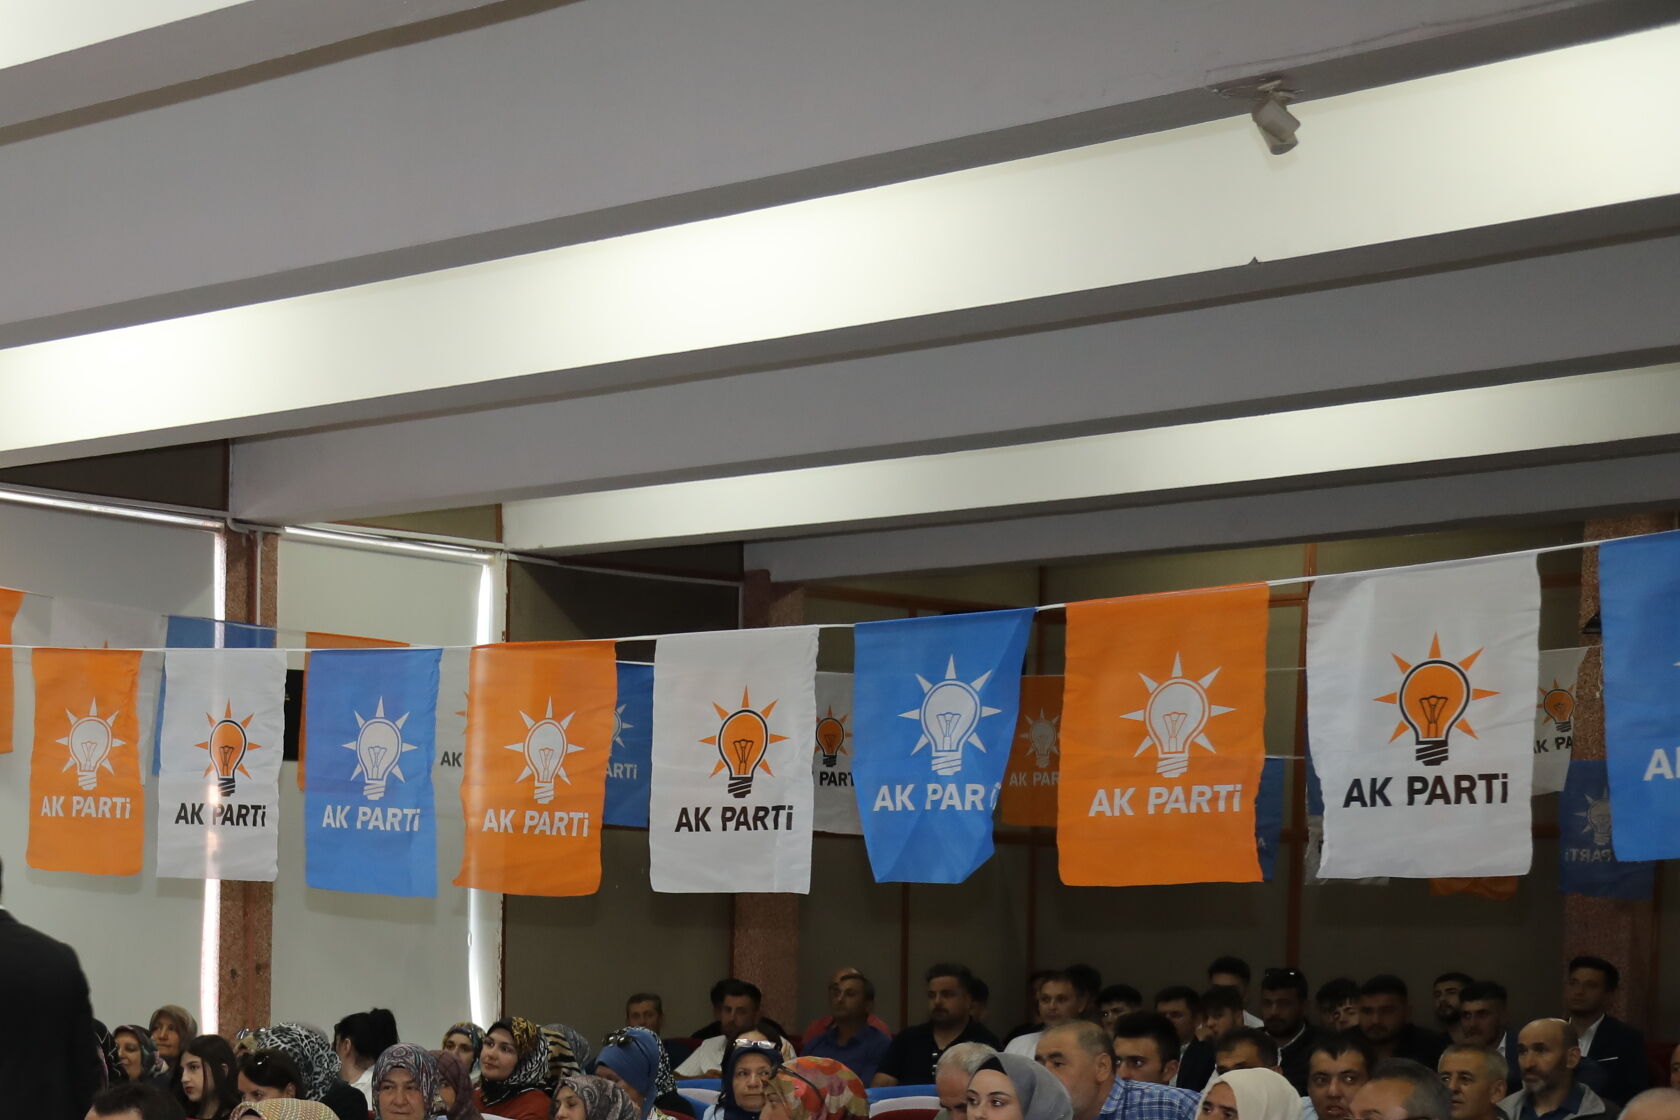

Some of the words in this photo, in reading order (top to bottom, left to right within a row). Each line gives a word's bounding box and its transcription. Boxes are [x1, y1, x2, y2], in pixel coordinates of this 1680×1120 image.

[440, 751, 462, 768] AK
[819, 771, 854, 787] PART
[1009, 771, 1027, 787] AK
[1032, 771, 1059, 787] PAR
[873, 783, 915, 812] AK
[1088, 787, 1136, 817] AK
[1342, 776, 1393, 809] AK
[40, 796, 64, 818] AK
[175, 802, 205, 826] AK
[321, 804, 351, 829] AK
[674, 806, 712, 833] AK
[481, 808, 517, 833] AK
